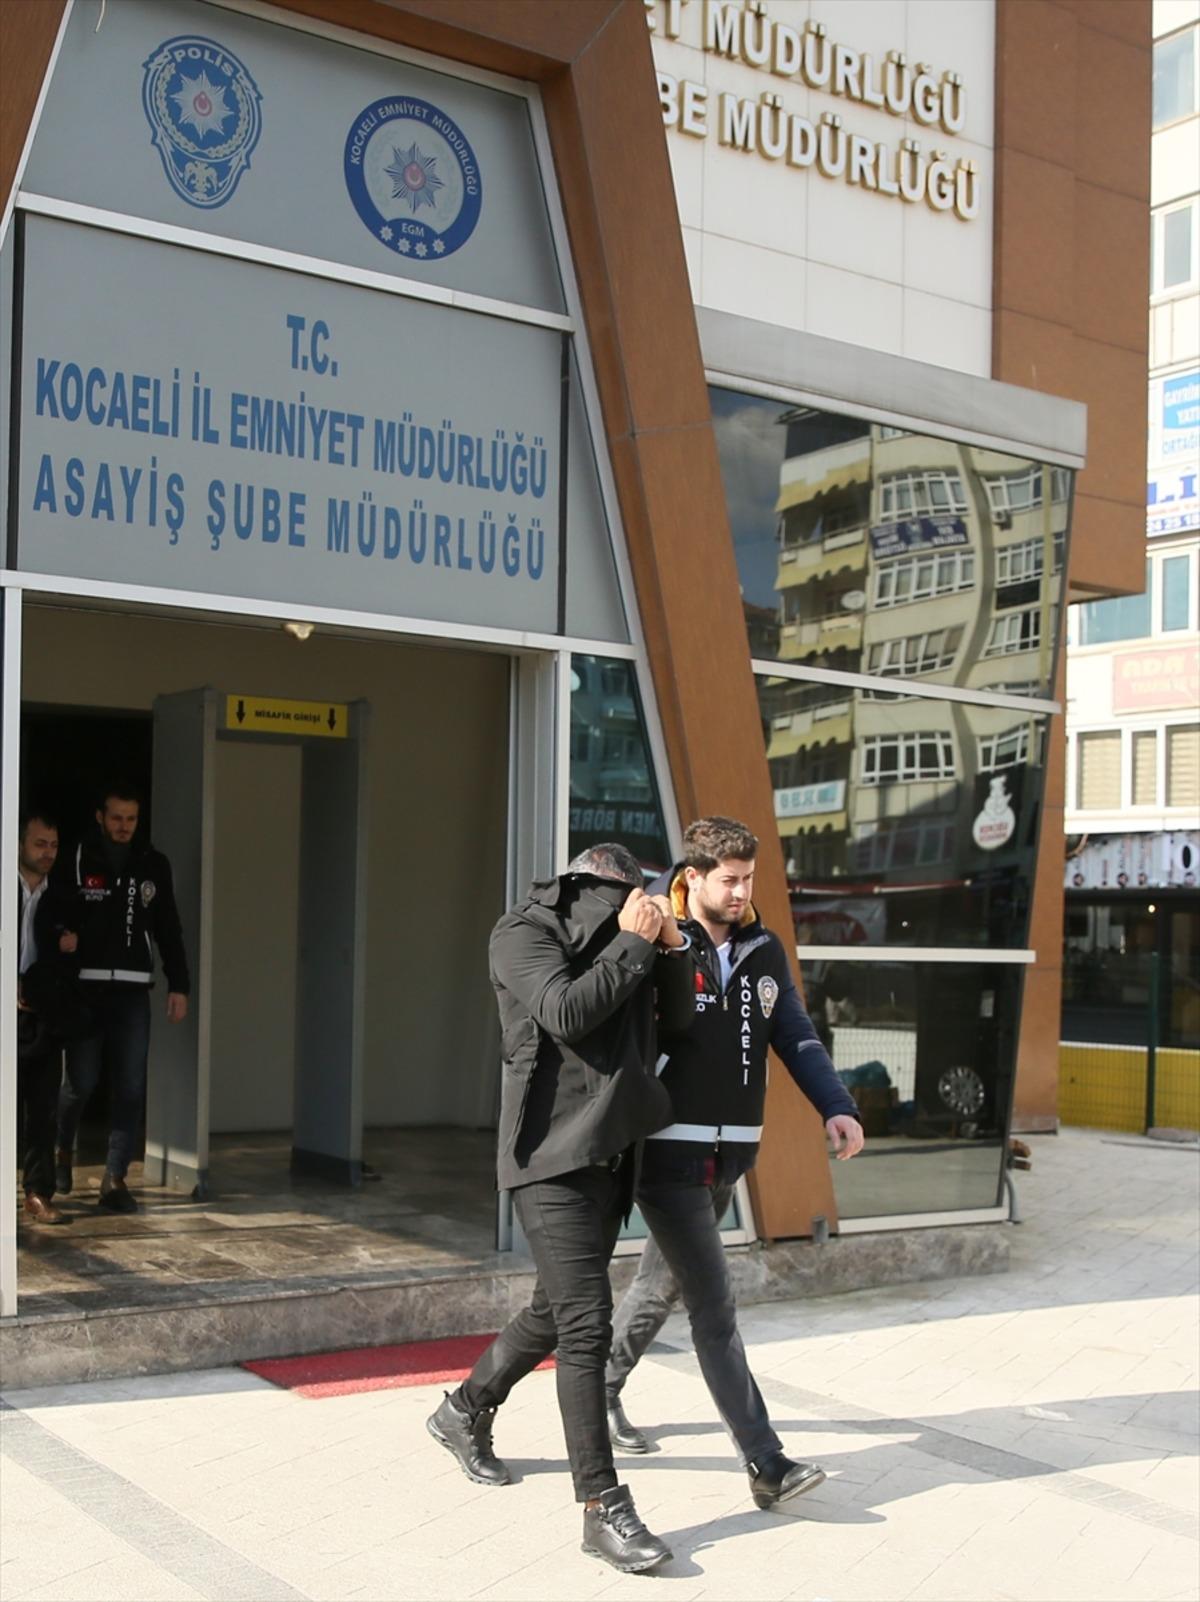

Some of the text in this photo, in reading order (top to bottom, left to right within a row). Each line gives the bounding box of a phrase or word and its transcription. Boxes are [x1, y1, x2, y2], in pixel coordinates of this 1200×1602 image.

[174, 47, 233, 77] POLİS
[703, 0, 966, 136] MÜDÜRLÜĞÜ
[350, 101, 477, 196] KOCAELİ EMNİYET MÜDÜRLÜĞÜ
[719, 92, 980, 220] MÜDÜRLÜĞÜ
[402, 223, 425, 237] EGM
[286, 314, 338, 377] T.C.
[36, 358, 547, 498] KOCAELİ İL EMNİYET MÜDÜRLÜĞÜ
[33, 454, 544, 580] ASAYİŞ ŞUBE MÜDÜRLÜĞÜ
[254, 708, 321, 724] MİSAFİR GİRİŞİ
